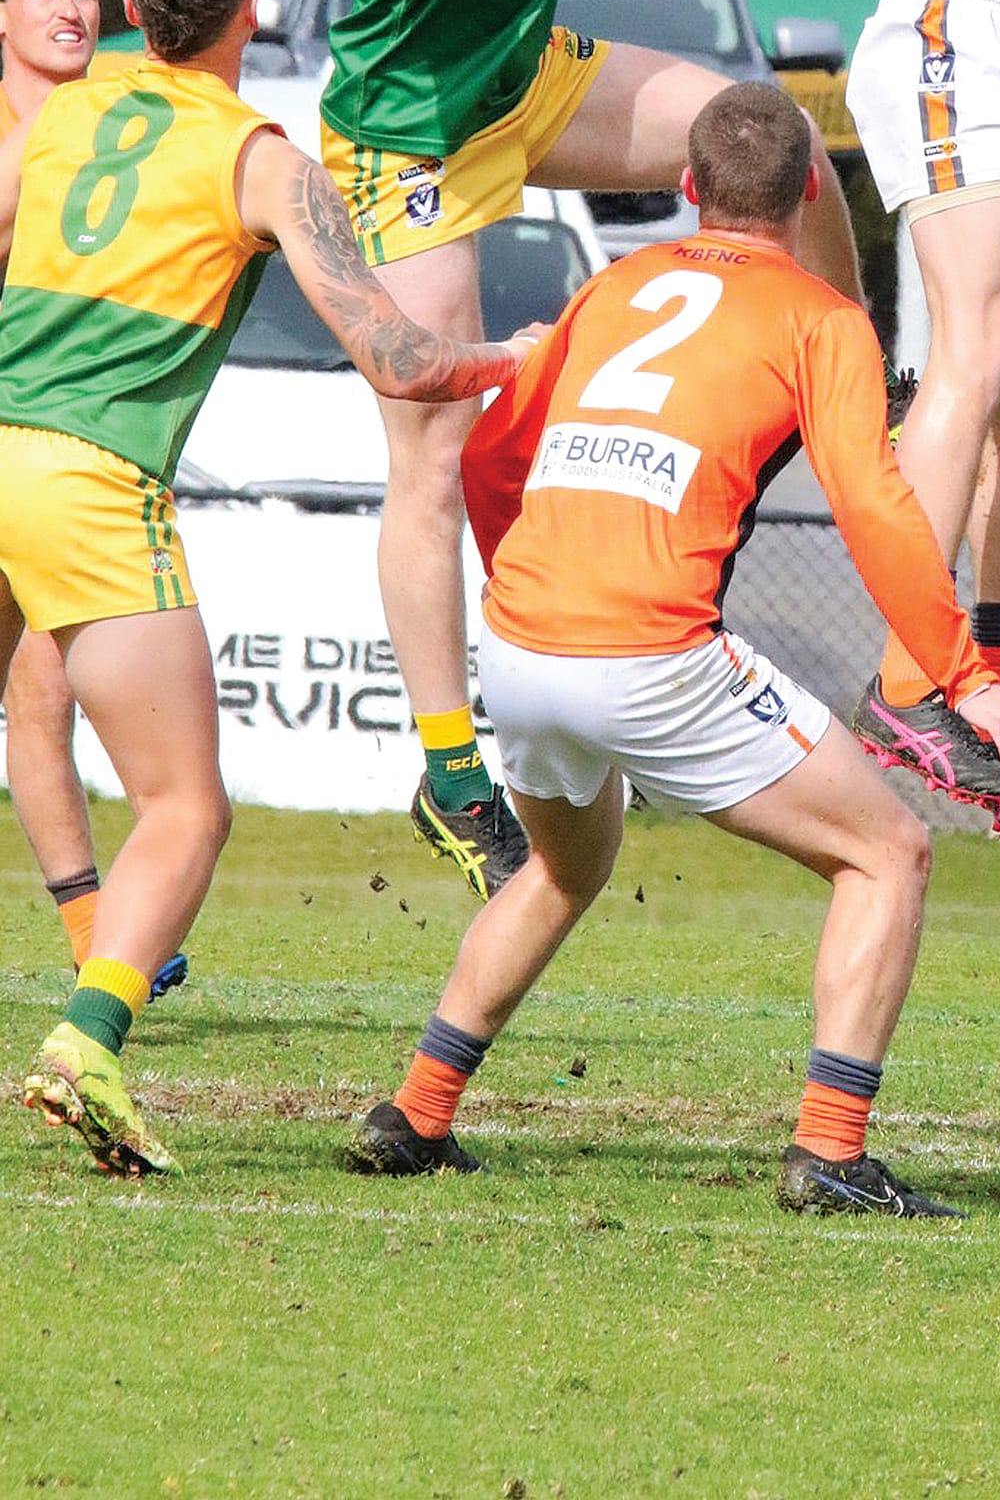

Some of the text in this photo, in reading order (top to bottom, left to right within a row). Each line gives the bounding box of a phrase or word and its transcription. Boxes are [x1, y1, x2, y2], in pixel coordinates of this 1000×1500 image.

[61, 89, 175, 256] 8
[673, 247, 751, 266] KBFNC
[577, 269, 724, 415] 2
[561, 464, 599, 478] FOODS
[566, 435, 677, 483] BURRA
